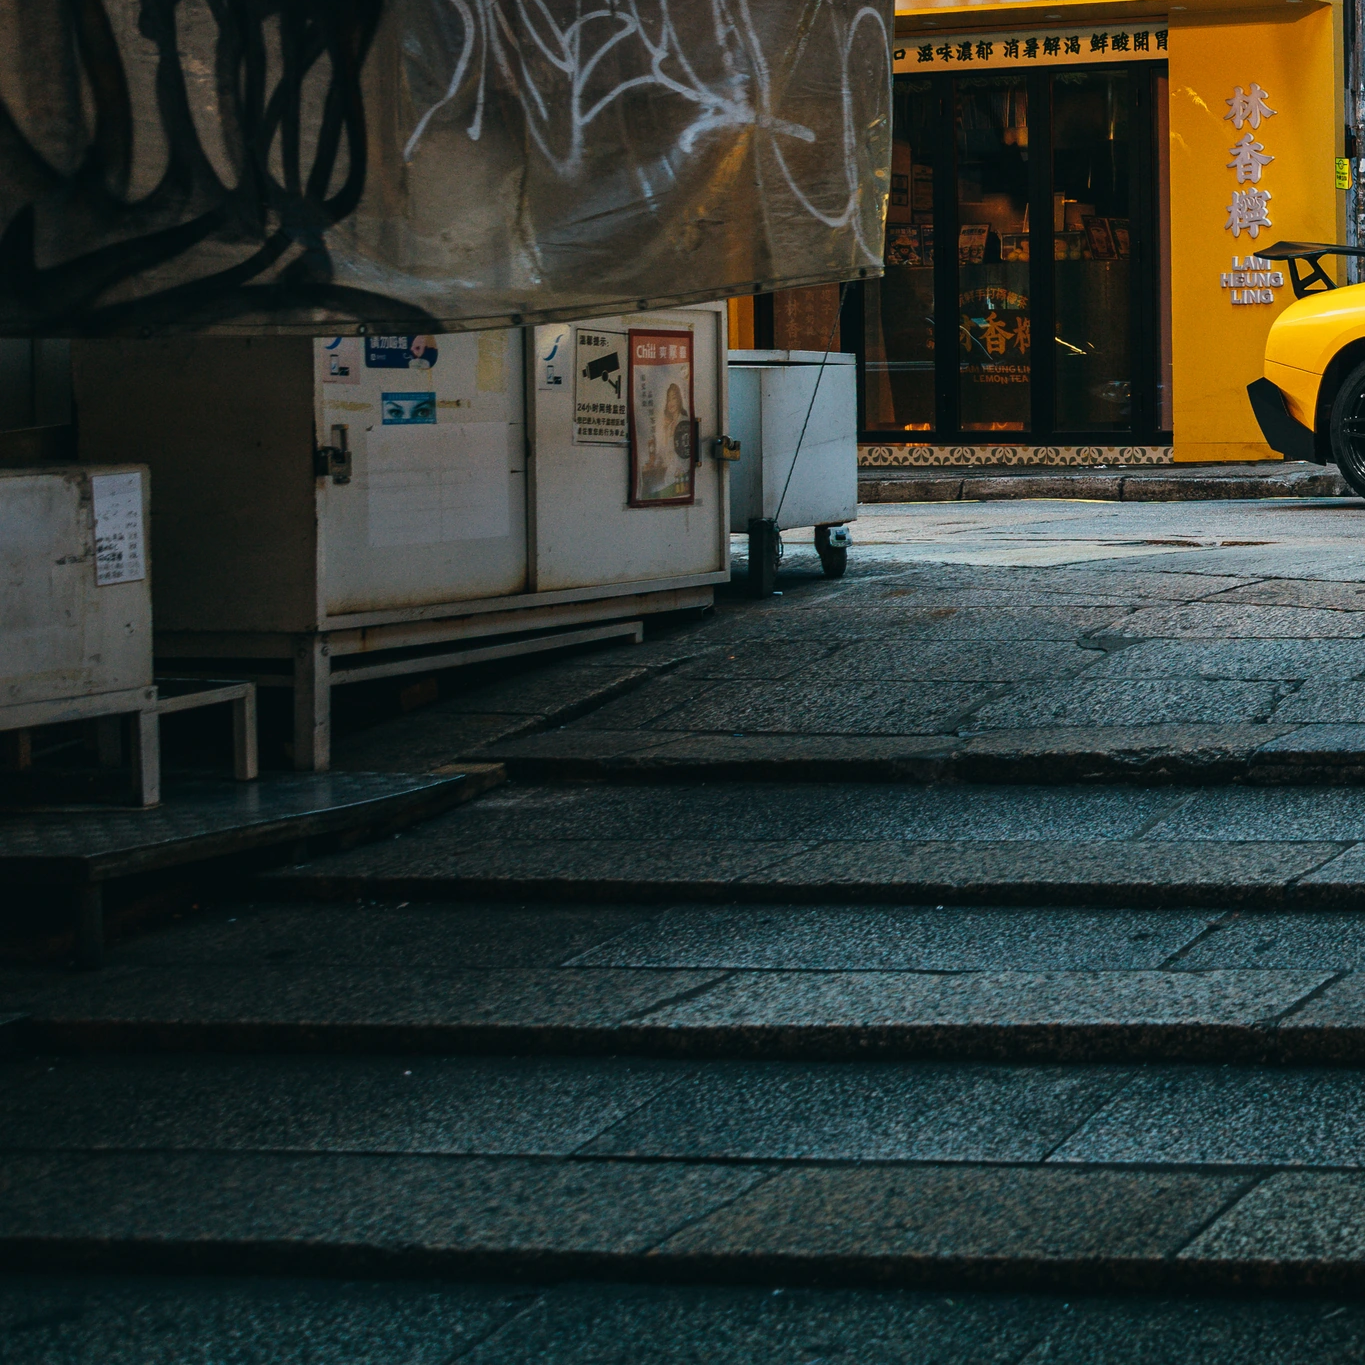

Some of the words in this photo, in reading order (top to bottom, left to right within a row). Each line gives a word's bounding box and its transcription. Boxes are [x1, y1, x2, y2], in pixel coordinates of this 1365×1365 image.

[917, 43, 994, 63] 滋味濃郁
[1003, 36, 1082, 58] 消暑解渴
[1224, 83, 1278, 239] 林香檸
[1232, 256, 1271, 271] LAM
[1220, 272, 1284, 288] HEUNG
[1231, 290, 1274, 305] LING
[983, 365, 1014, 374] HEUNG
[974, 374, 1007, 384] LEMON
[1010, 374, 1029, 383] TEA
